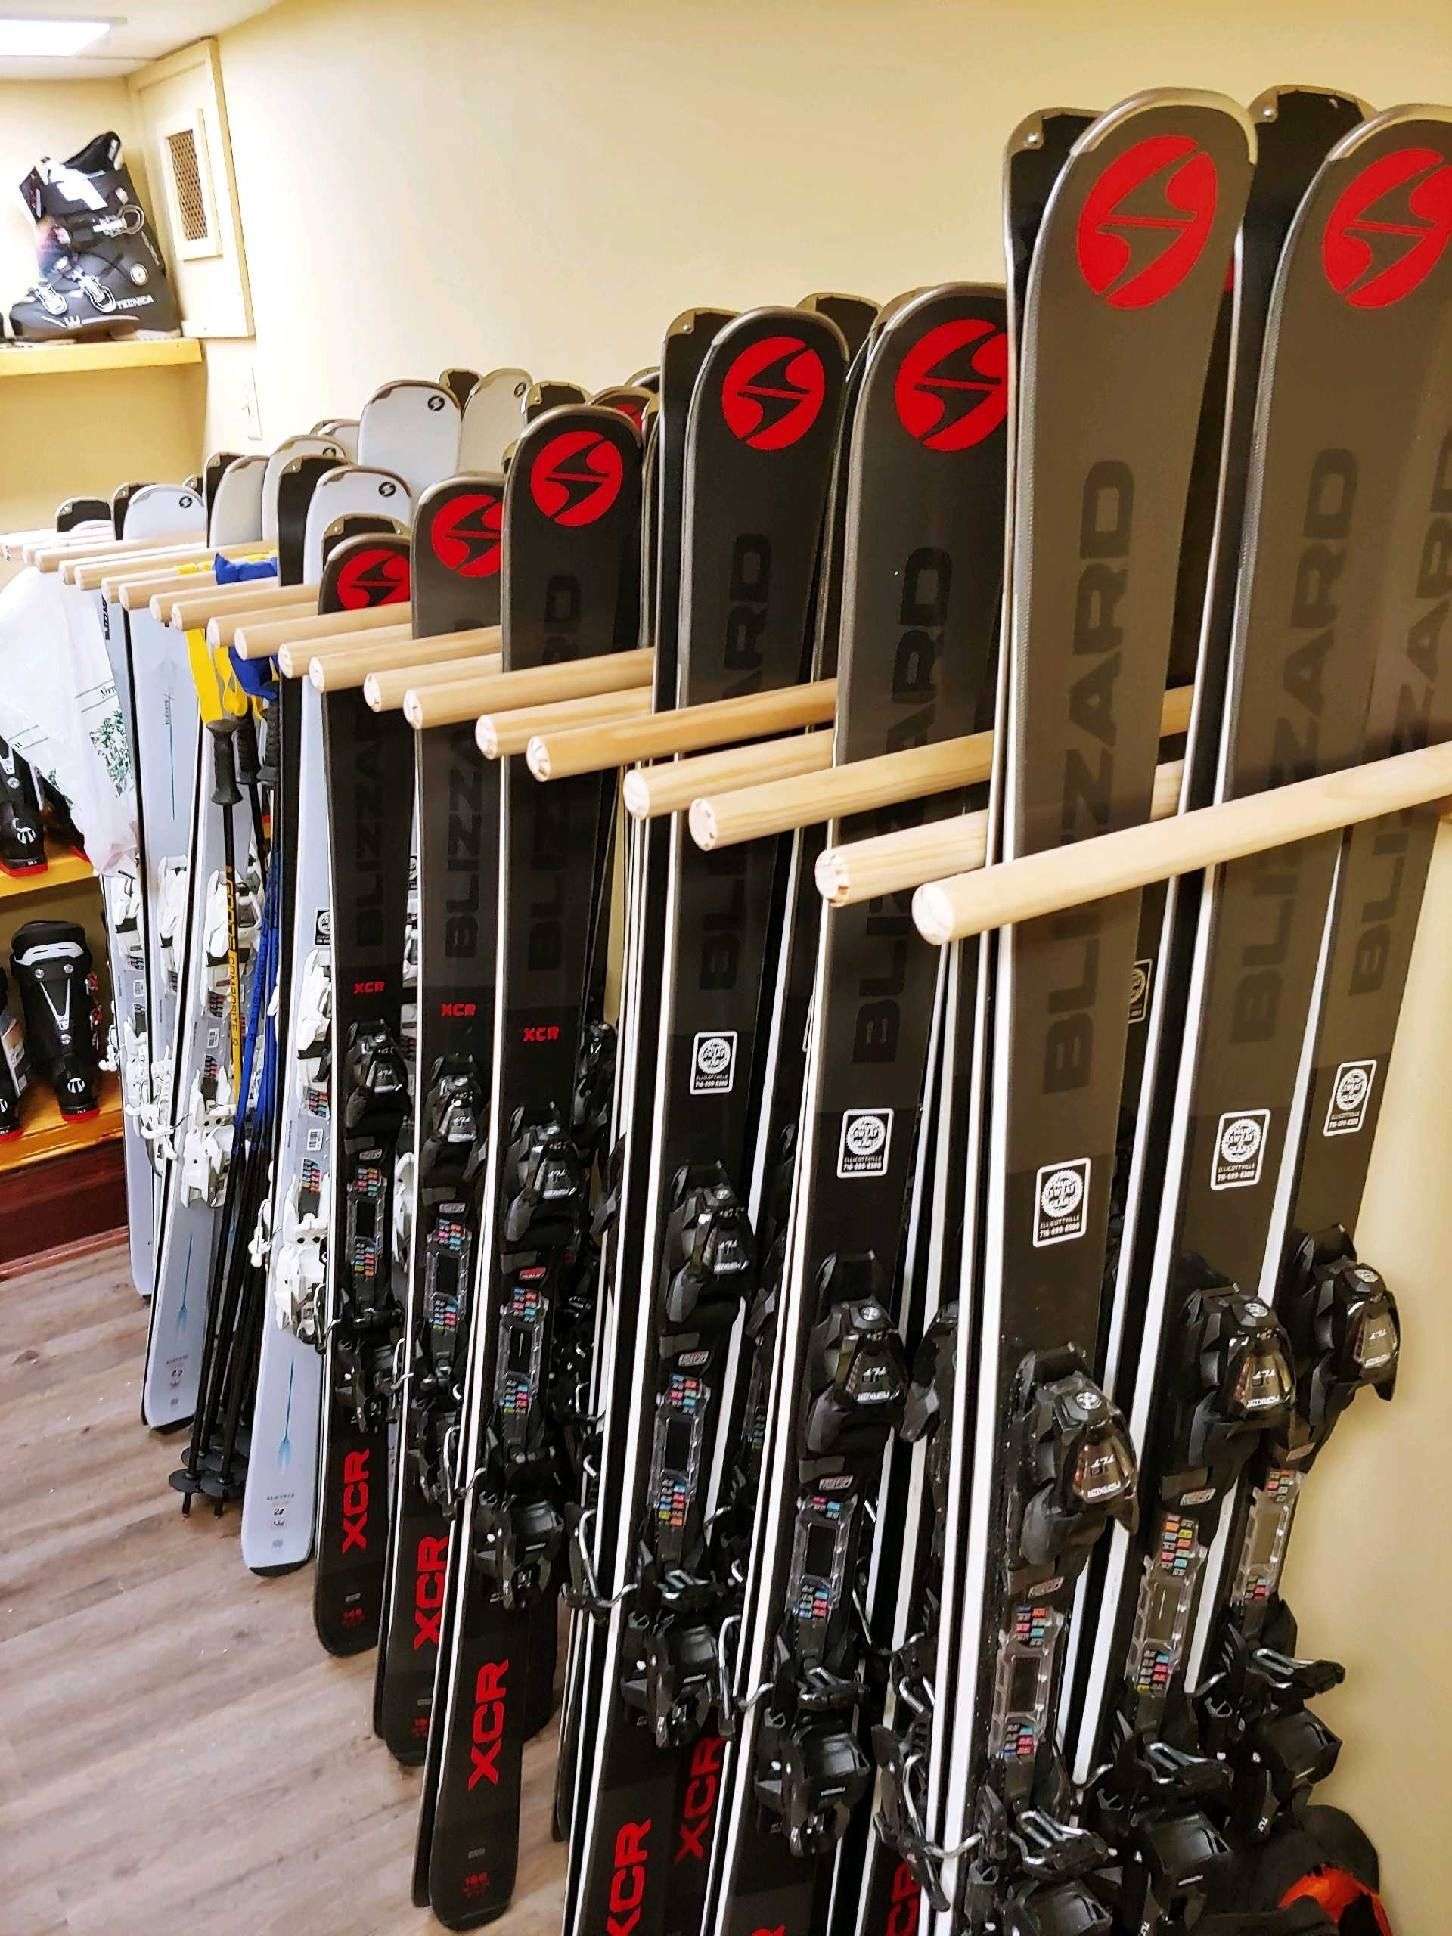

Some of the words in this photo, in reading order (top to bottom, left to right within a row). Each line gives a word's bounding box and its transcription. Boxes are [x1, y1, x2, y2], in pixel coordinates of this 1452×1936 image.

[115, 295, 154, 311] TECNICA
[1044, 460, 1135, 1094] BLIZARD
[1229, 447, 1359, 1043] BLIZARD
[354, 981, 385, 993] XCR
[441, 1003, 477, 1017] XCR
[523, 1026, 560, 1042] XCR
[342, 1449, 370, 1553] XCR
[413, 1536, 449, 1649] XCR
[467, 1660, 509, 1789] XCR
[674, 1735, 727, 1864] XCR
